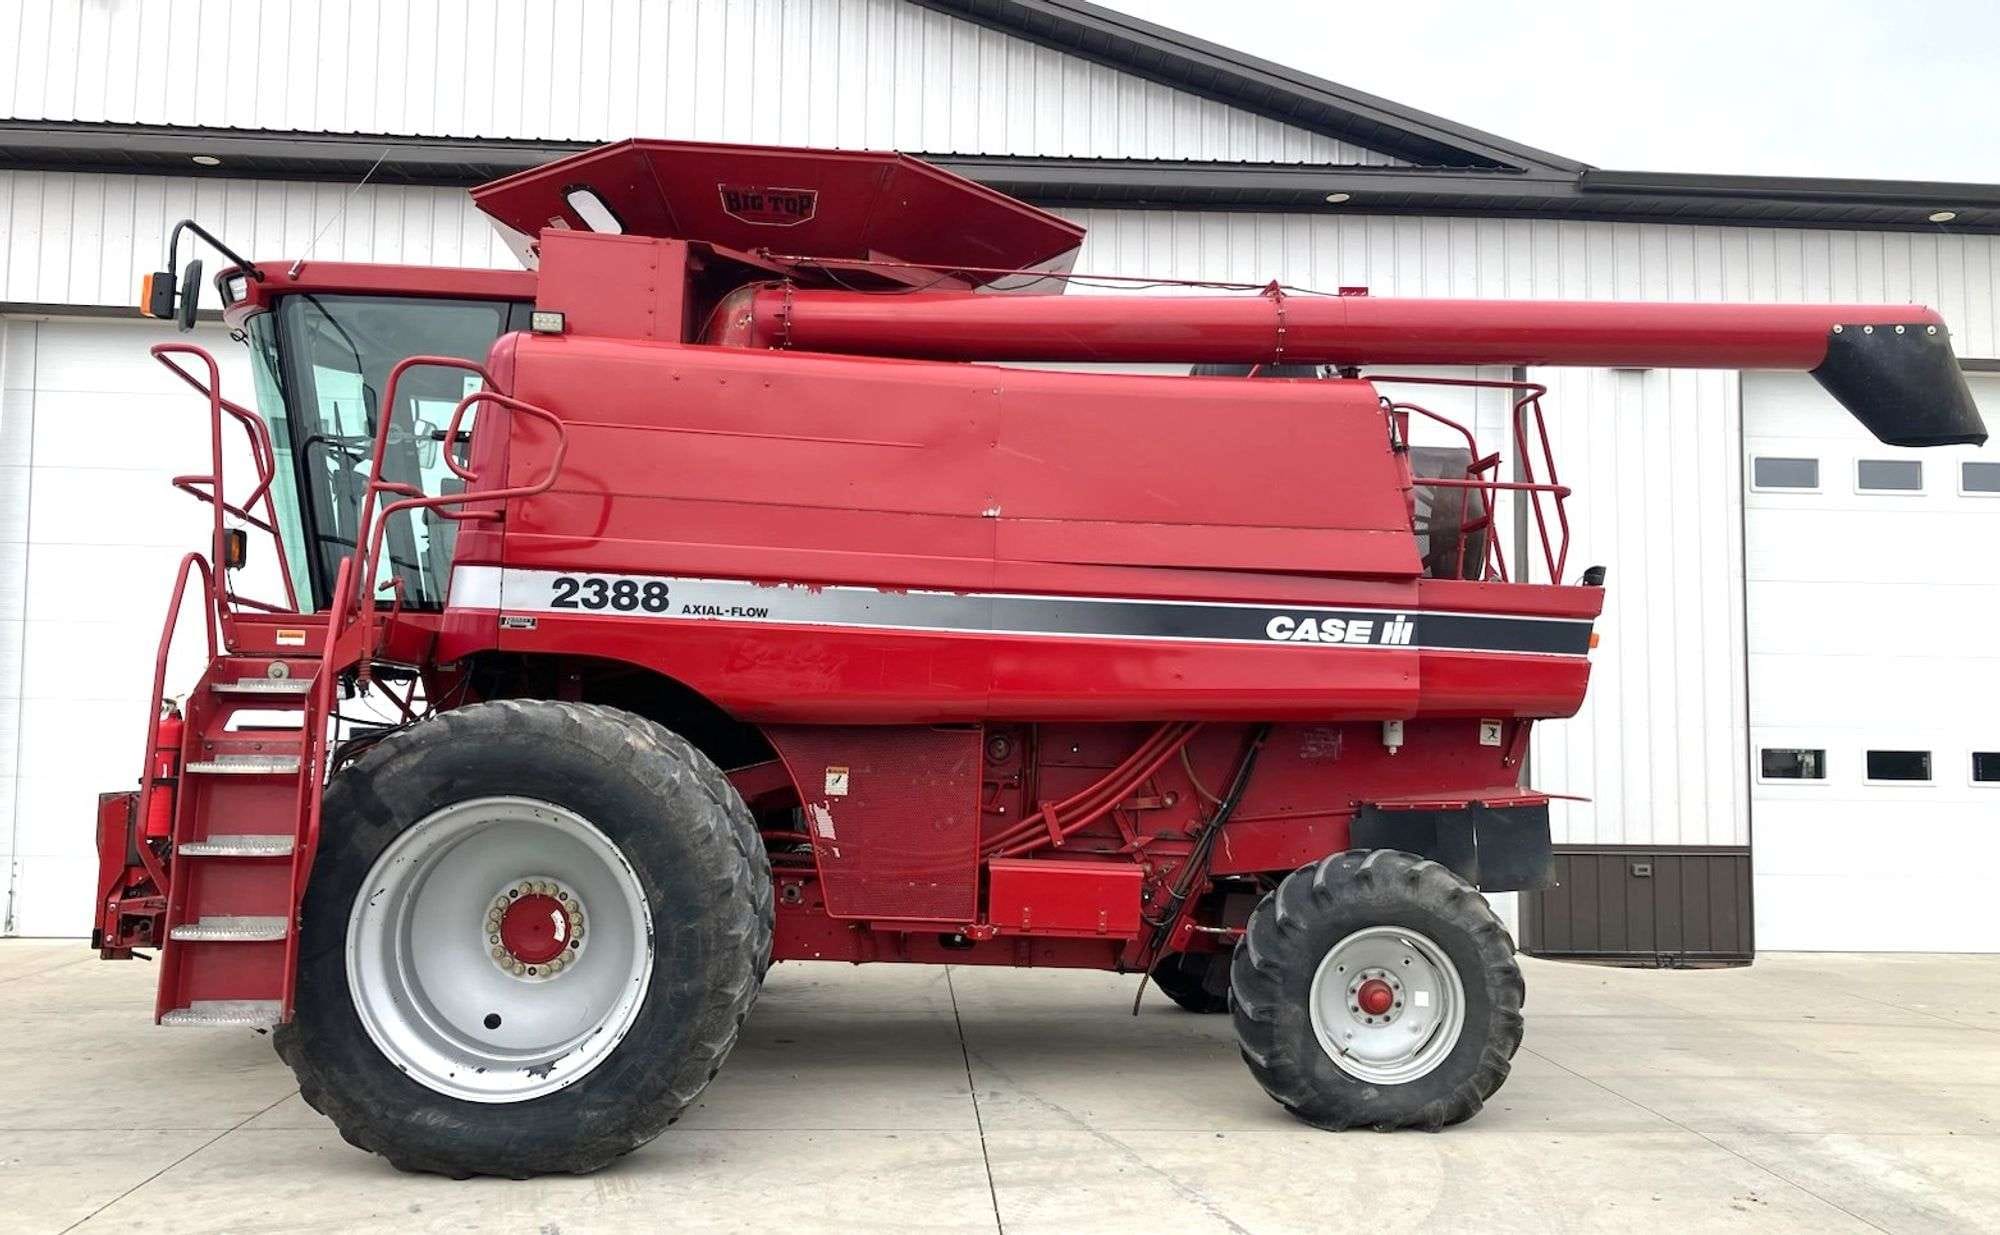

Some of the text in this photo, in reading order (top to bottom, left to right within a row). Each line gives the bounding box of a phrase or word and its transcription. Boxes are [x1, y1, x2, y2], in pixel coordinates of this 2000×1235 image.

[550, 577, 670, 613] 2388
[681, 604, 769, 618] AXIAL-FLOW
[1265, 615, 1375, 644] CASE
